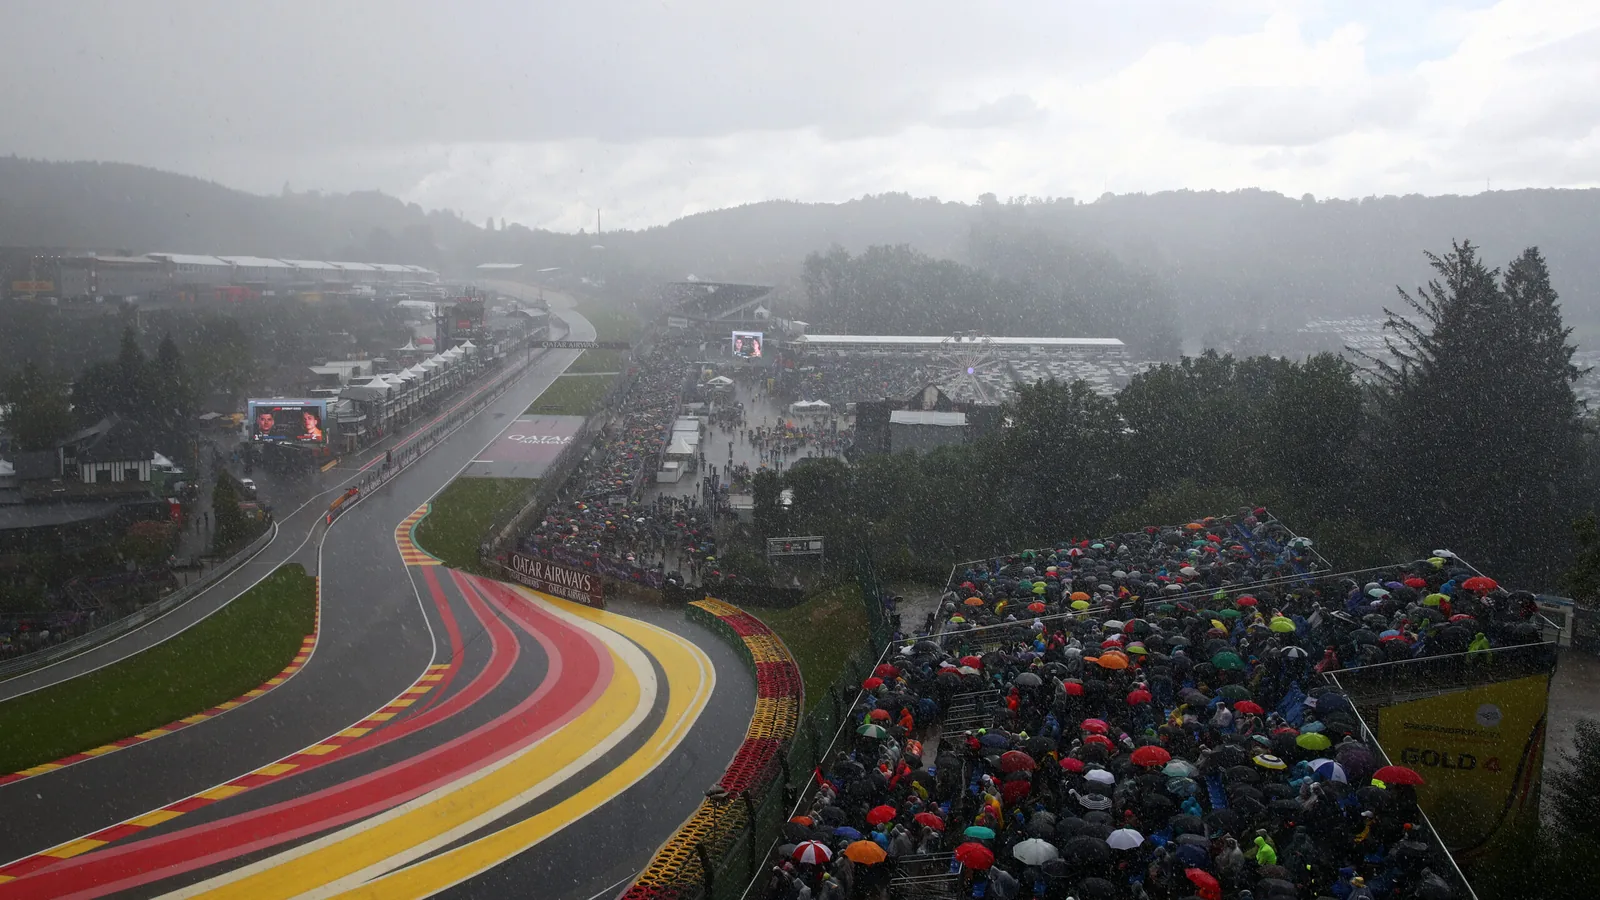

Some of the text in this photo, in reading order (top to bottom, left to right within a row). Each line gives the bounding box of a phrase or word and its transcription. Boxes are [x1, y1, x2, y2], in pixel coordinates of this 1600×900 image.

[542, 341, 567, 349] QATAR
[513, 554, 591, 591] QATAR AIRWAYS
[548, 583, 567, 597] QATAR
[1401, 747, 1502, 773] GOLD 4
